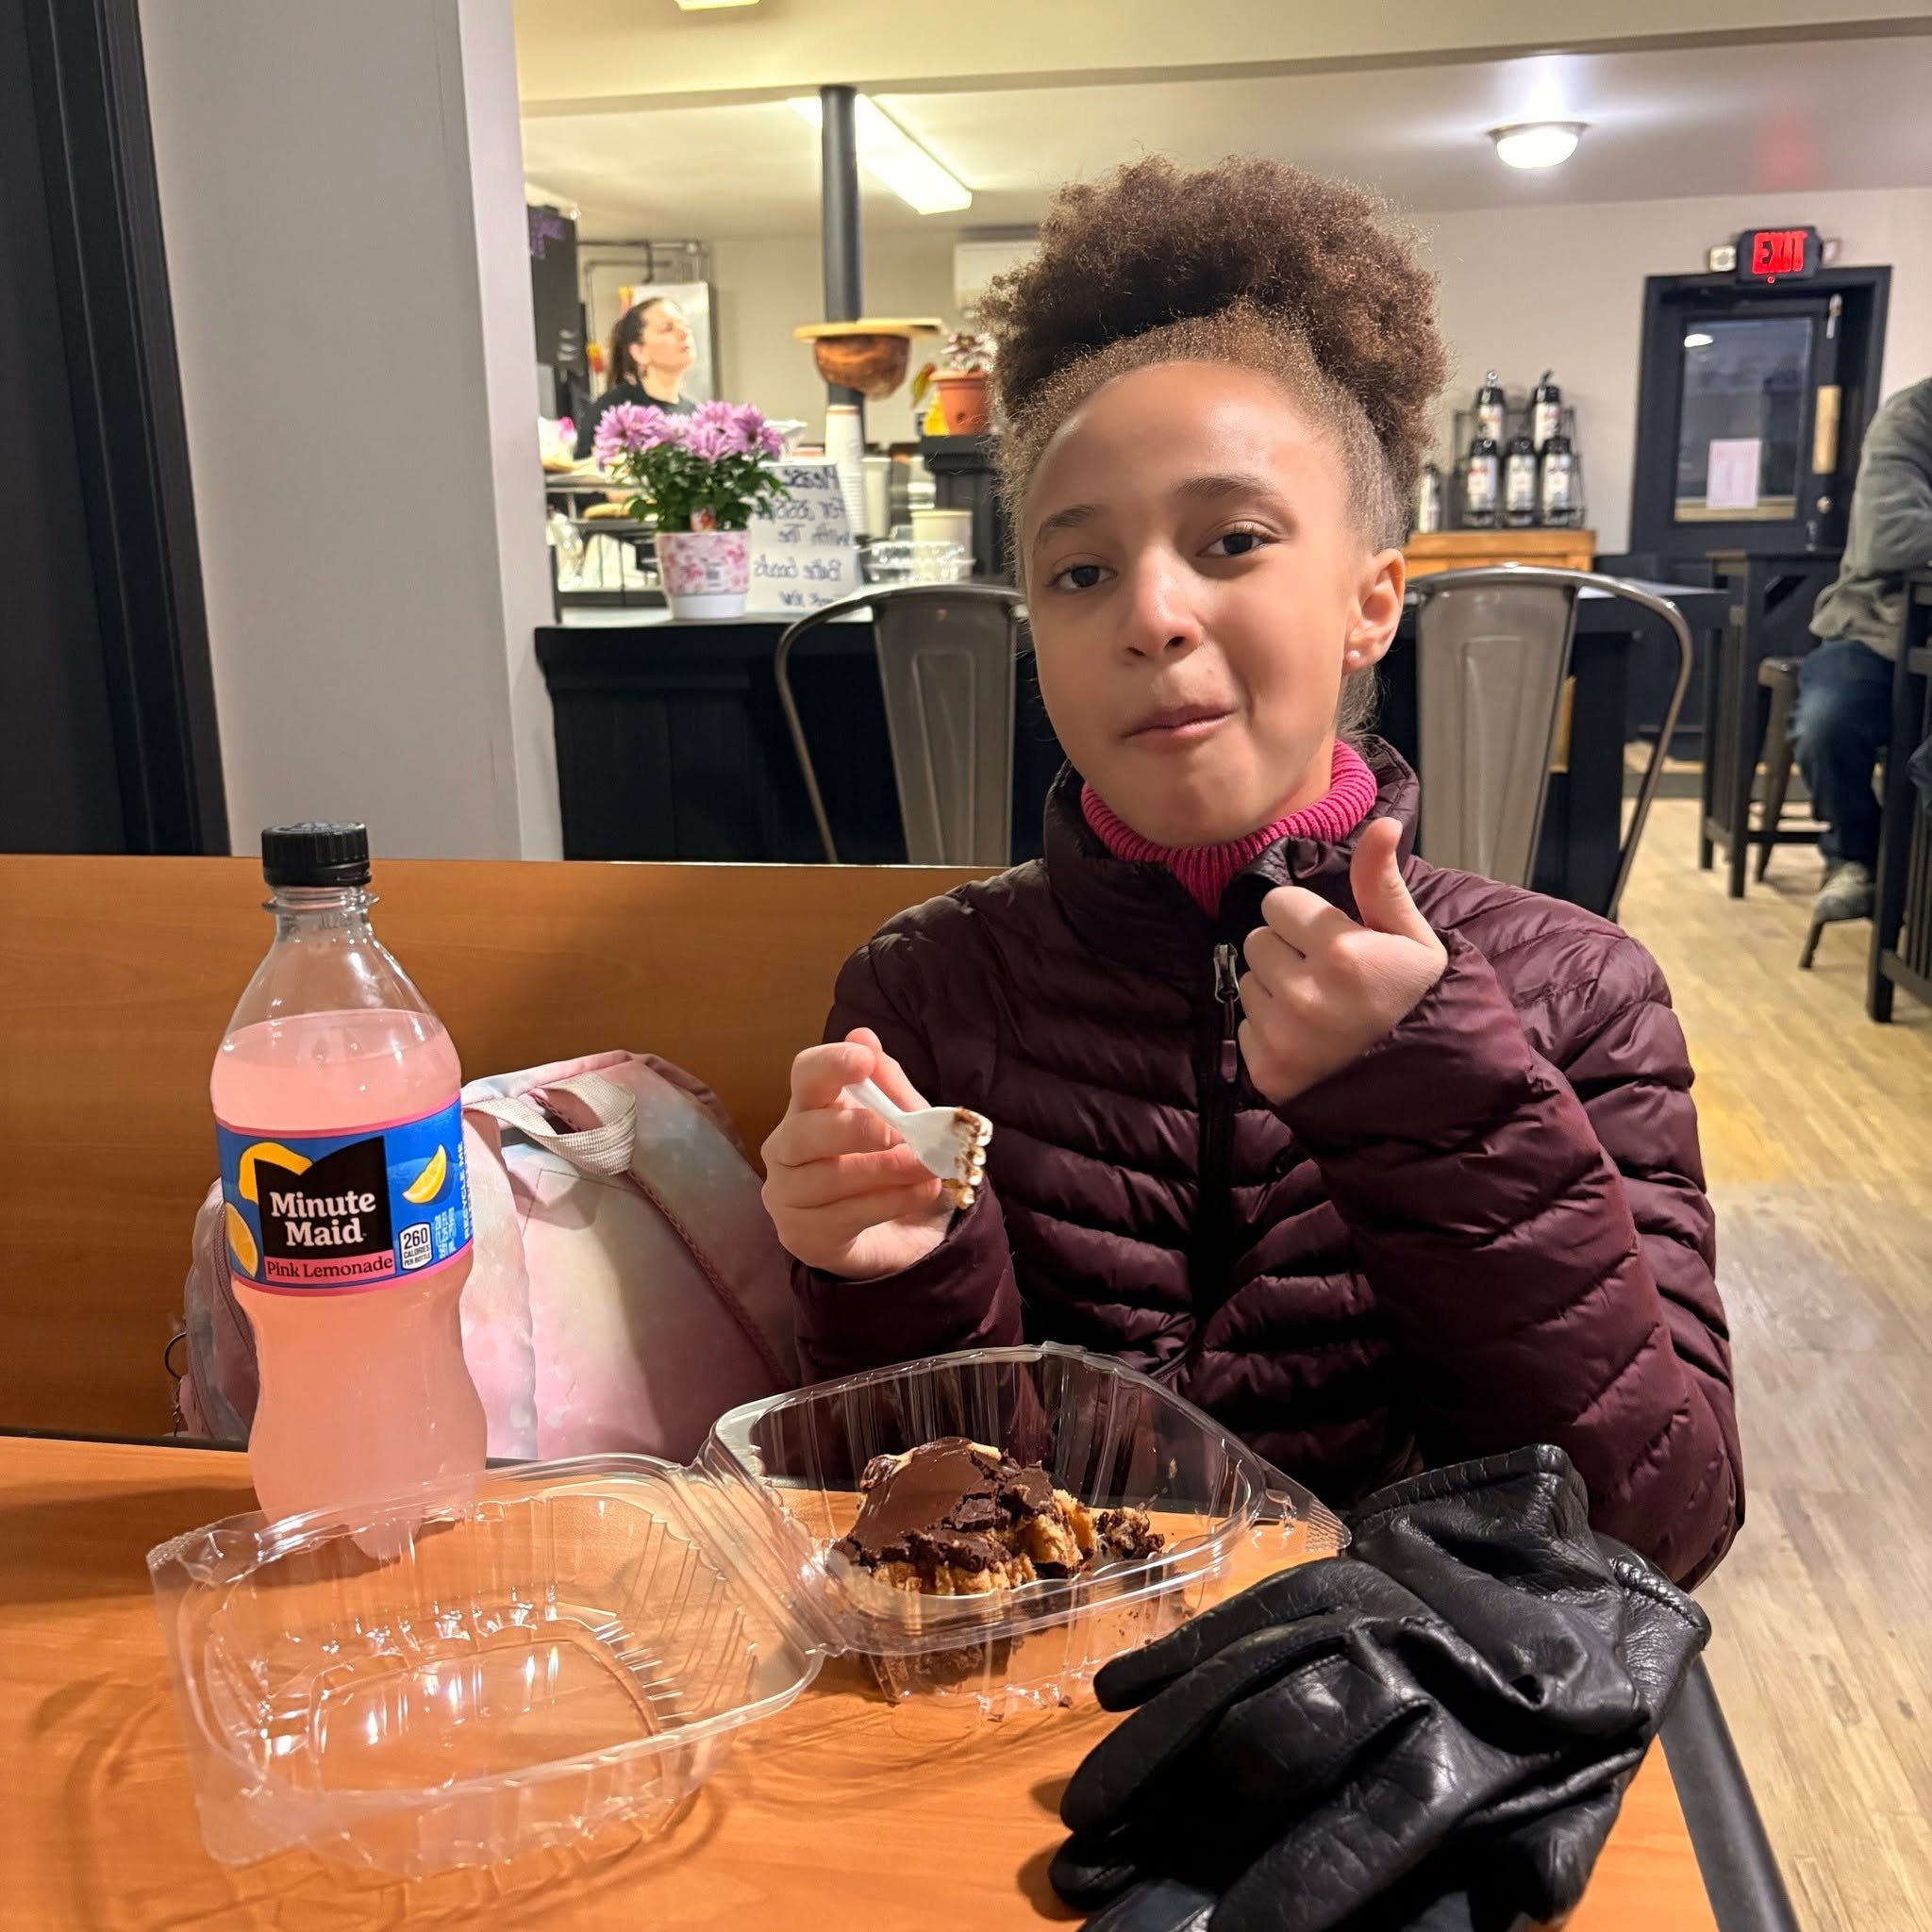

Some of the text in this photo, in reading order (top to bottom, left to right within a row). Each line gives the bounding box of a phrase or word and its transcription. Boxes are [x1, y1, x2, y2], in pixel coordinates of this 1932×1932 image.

[1752, 229, 1807, 275] EXIT
[270, 1191, 376, 1218] Minute
[285, 1217, 364, 1247] Maid
[404, 1227, 428, 1250] 260
[404, 1244, 430, 1259] CALORIES
[415, 1252, 431, 1263] BOTTLE
[267, 1256, 393, 1277] Pink Lemonade
